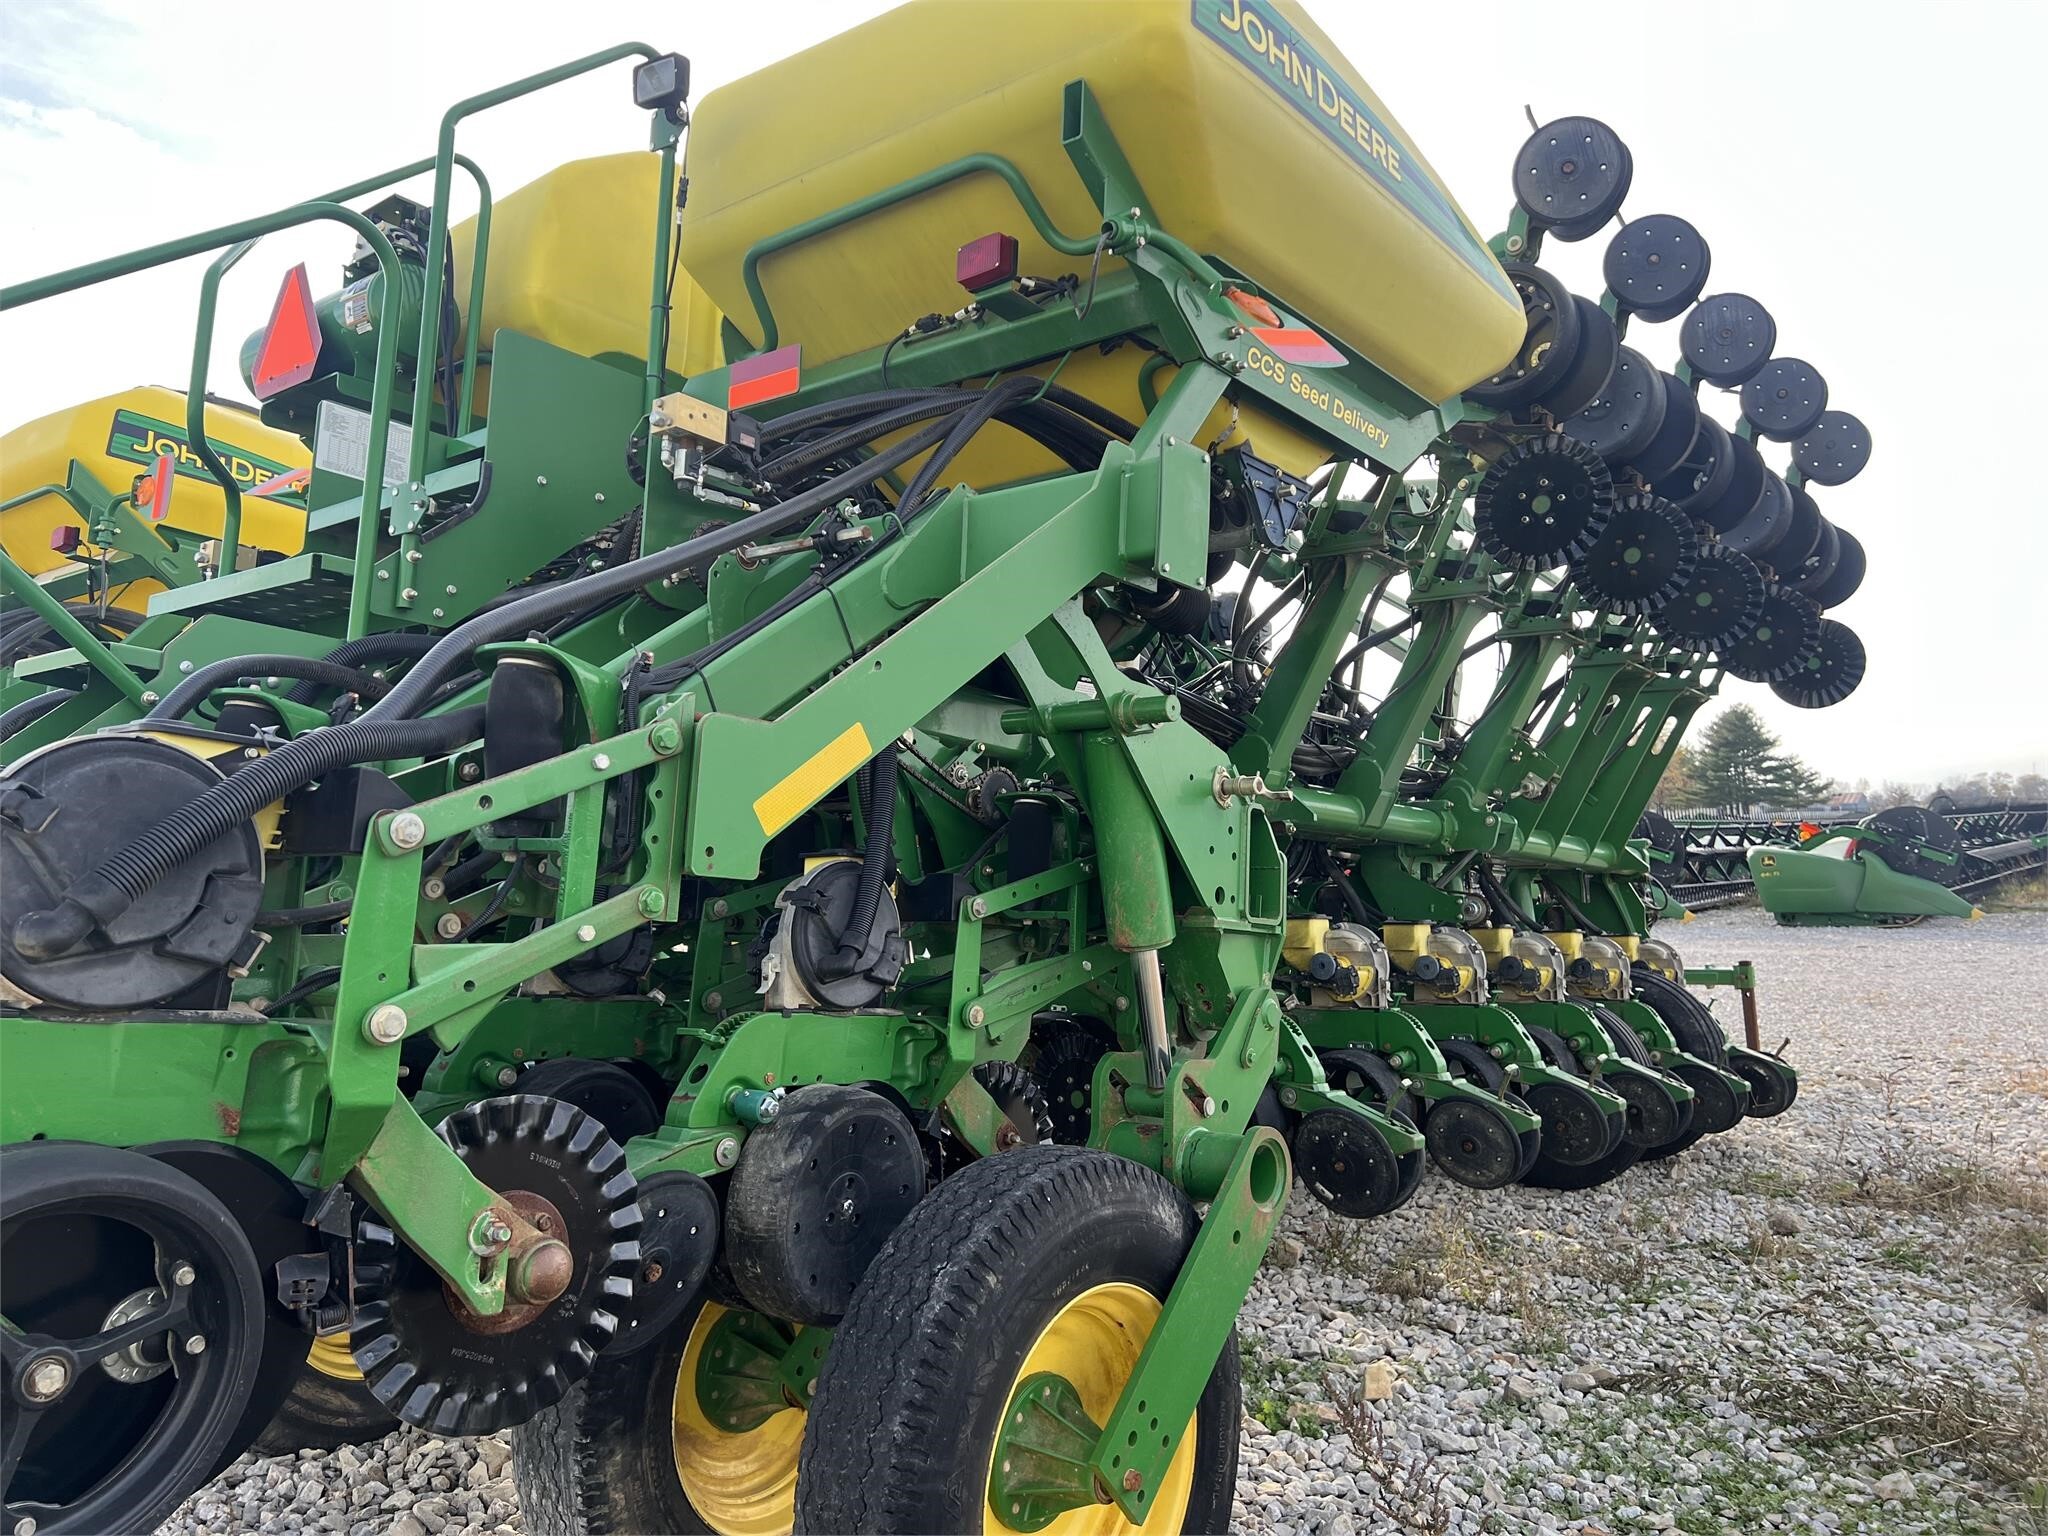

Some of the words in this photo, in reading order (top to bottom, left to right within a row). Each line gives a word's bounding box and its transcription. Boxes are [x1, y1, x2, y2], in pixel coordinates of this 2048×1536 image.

[1220, 0, 1313, 98] JOHN
[1316, 68, 1402, 182] DEERE
[1247, 347, 1286, 385] CCS
[1289, 372, 1330, 411] Seed
[1332, 397, 1390, 449] Delivery
[133, 430, 226, 470] JOH
